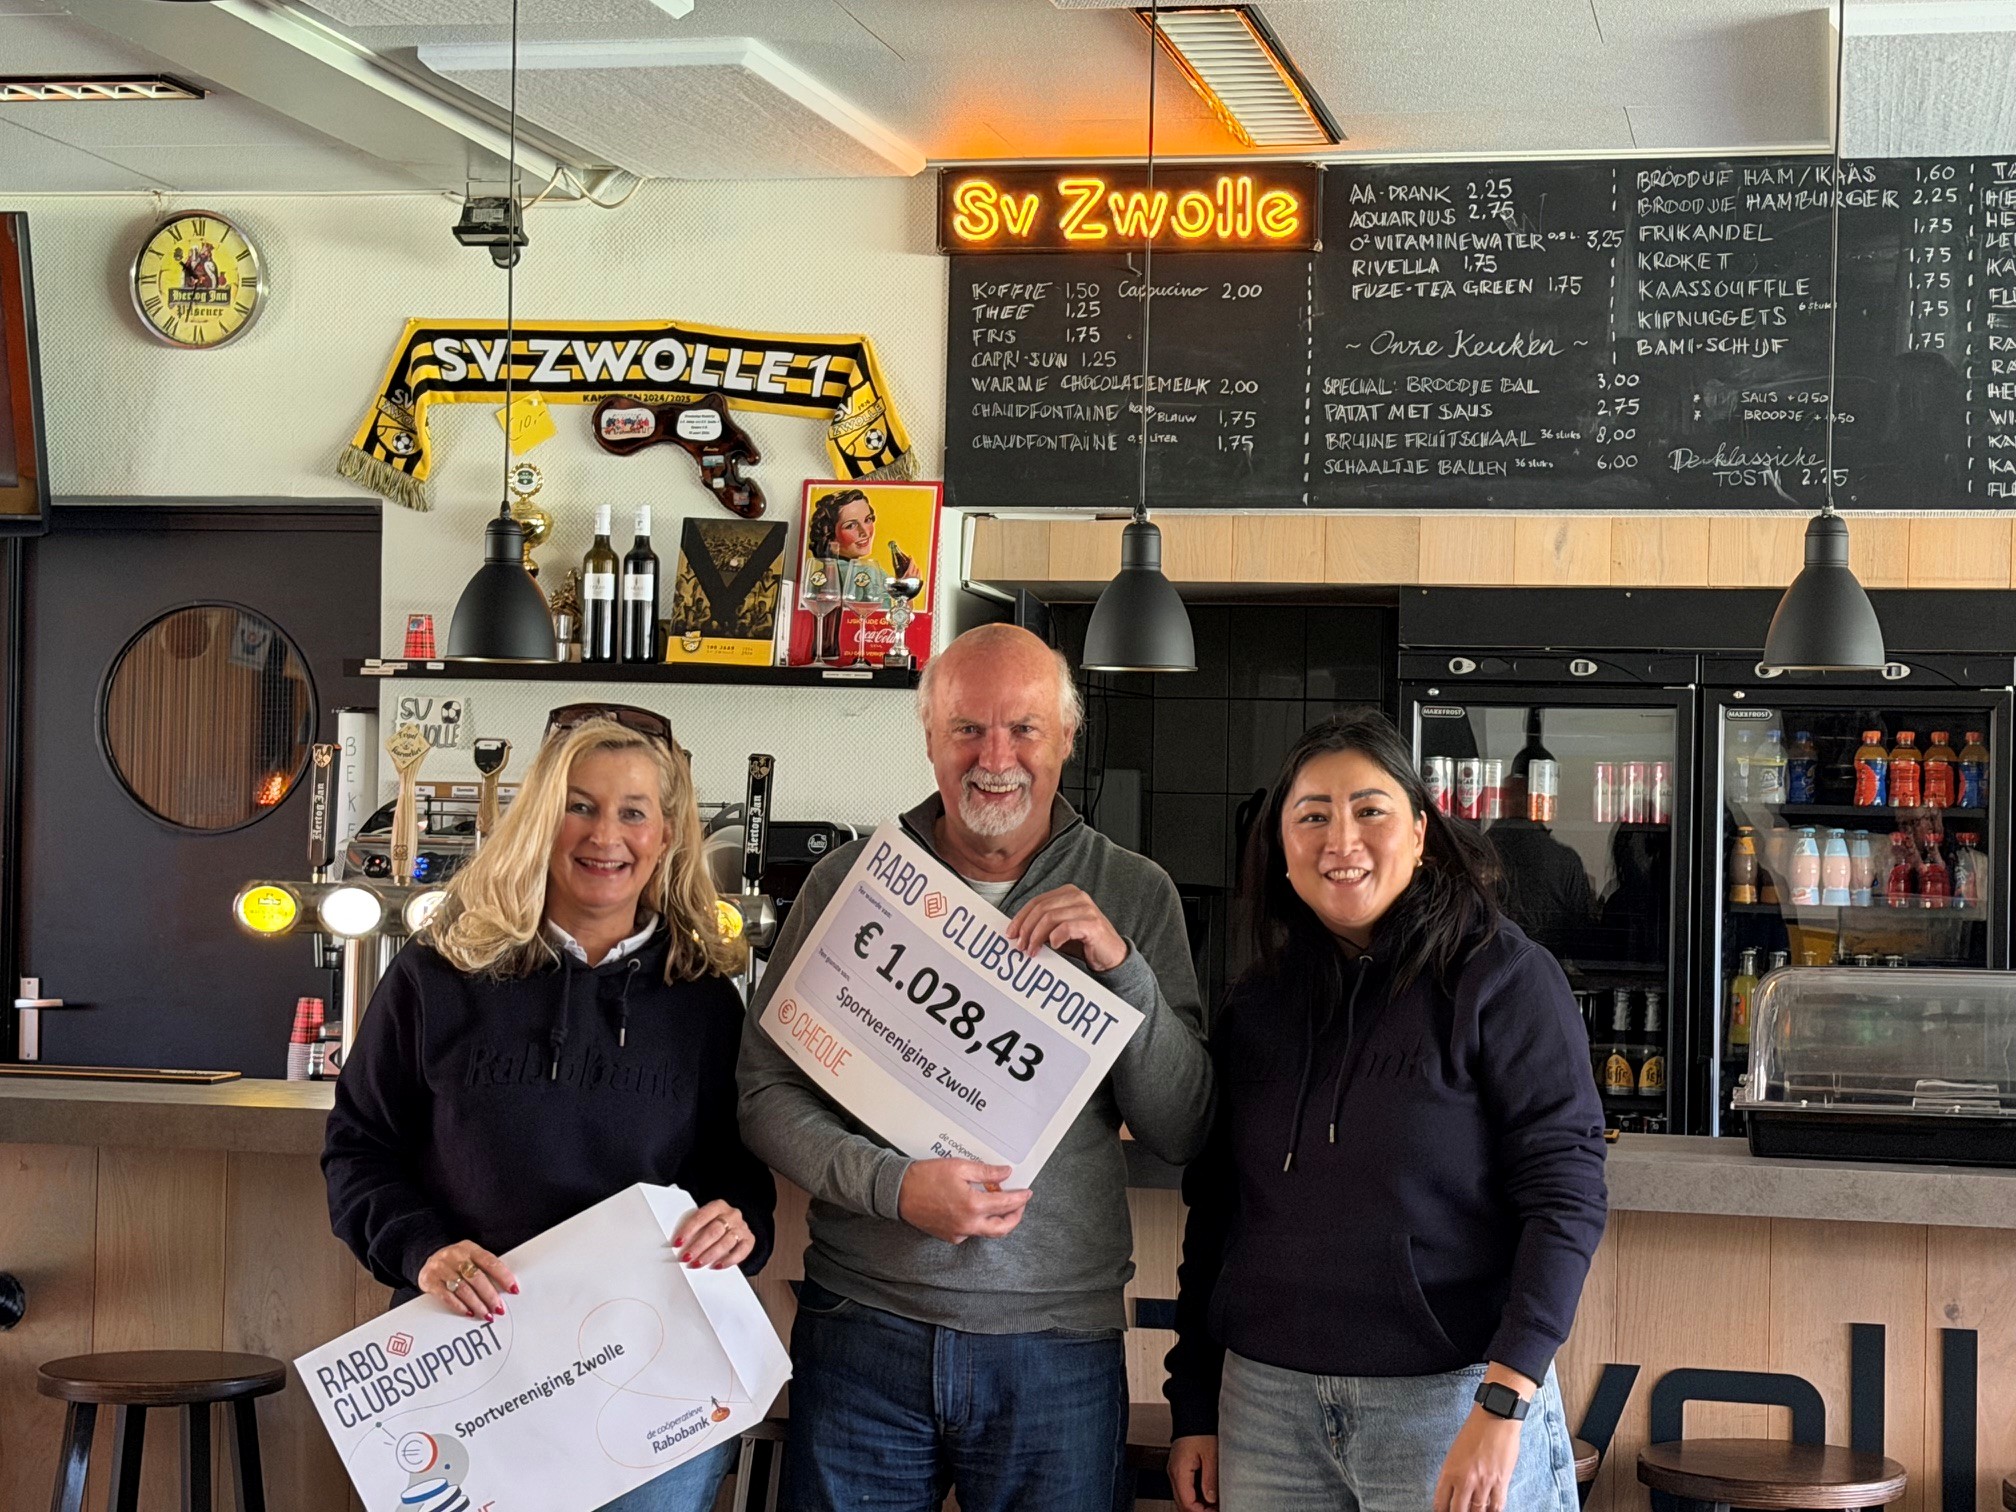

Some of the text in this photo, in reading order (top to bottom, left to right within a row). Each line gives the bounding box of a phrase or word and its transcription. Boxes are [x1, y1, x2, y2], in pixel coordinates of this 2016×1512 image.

[1916, 166, 1955, 183] 1,60
[1350, 178, 1512, 204] AA-DRANK 2,25
[1637, 188, 1957, 216] BROODJE HAMBURGER 2,25
[953, 175, 1299, 241] Sv Zwolle
[1350, 201, 1514, 228] AQUARIUS 2,75
[1374, 231, 1545, 251] VITAMINEWATER
[1587, 230, 1624, 250] 3,25
[1639, 218, 1953, 243] FRIKANDEL 1,75
[1352, 254, 1497, 276] RIVELLA 1,75
[1638, 247, 1951, 271] KROKET 1,75
[972, 282, 1053, 300] KOFFIE
[1066, 283, 1099, 299] 1,50
[1222, 283, 1262, 300] 2,00
[1463, 278, 1533, 295] GREEN
[1549, 276, 1583, 293] 1,75
[1638, 273, 1951, 300] KAASSOUFFLE 1,75
[972, 301, 1101, 323] THEE 1,25
[1638, 306, 1787, 328] KIPNUGGETS
[1909, 300, 1949, 317] 1,75
[972, 326, 1100, 346] FRIS 1,75
[1370, 328, 1565, 359] Onze Keuken
[1908, 333, 1945, 350] 1,75
[433, 338, 832, 399] SV ZWOLLE 1
[1082, 351, 1117, 367] 1,25
[972, 376, 1049, 392] WARME
[1220, 379, 1259, 394] 2,00
[1407, 376, 1493, 396] BROODJE
[1500, 377, 1540, 394] BAL
[1597, 373, 1639, 390] 3,00
[1741, 391, 1778, 403] SAUS
[972, 402, 1119, 422] CHAUDFONTAINE
[1219, 411, 1256, 428] 1,75
[1324, 398, 1640, 422] PATAT MET SAUS 2,75
[1744, 409, 1804, 421] BROODJE
[972, 434, 1119, 451] CHAUDFONTAINE
[1218, 435, 1255, 452] 1,75
[1325, 433, 1399, 450] BRUINE
[1404, 430, 1537, 448] FRUITSCHAAL
[1596, 426, 1636, 444] 8,00
[1324, 458, 1429, 475] SCHAALTJE
[1438, 459, 1507, 477] BALLEN
[1597, 455, 1638, 470] 6,00
[854, 627, 898, 644] Cca-Cola
[400, 697, 433, 721] SV
[747, 816, 762, 854] Hertog
[867, 840, 1119, 1046] RABO CLUBSUPPORT
[854, 921, 1045, 1083] € 1.028,43
[792, 1012, 852, 1077] CHEQUE
[836, 986, 988, 1112] Sportvereniging Zwolle
[316, 1342, 388, 1399] RABO
[334, 1321, 502, 1428] CLUBSUPPORT
[455, 1342, 625, 1439] Sportvereniging Zwolle
[646, 1429, 657, 1440] de
[652, 1416, 710, 1453] Rabobank
